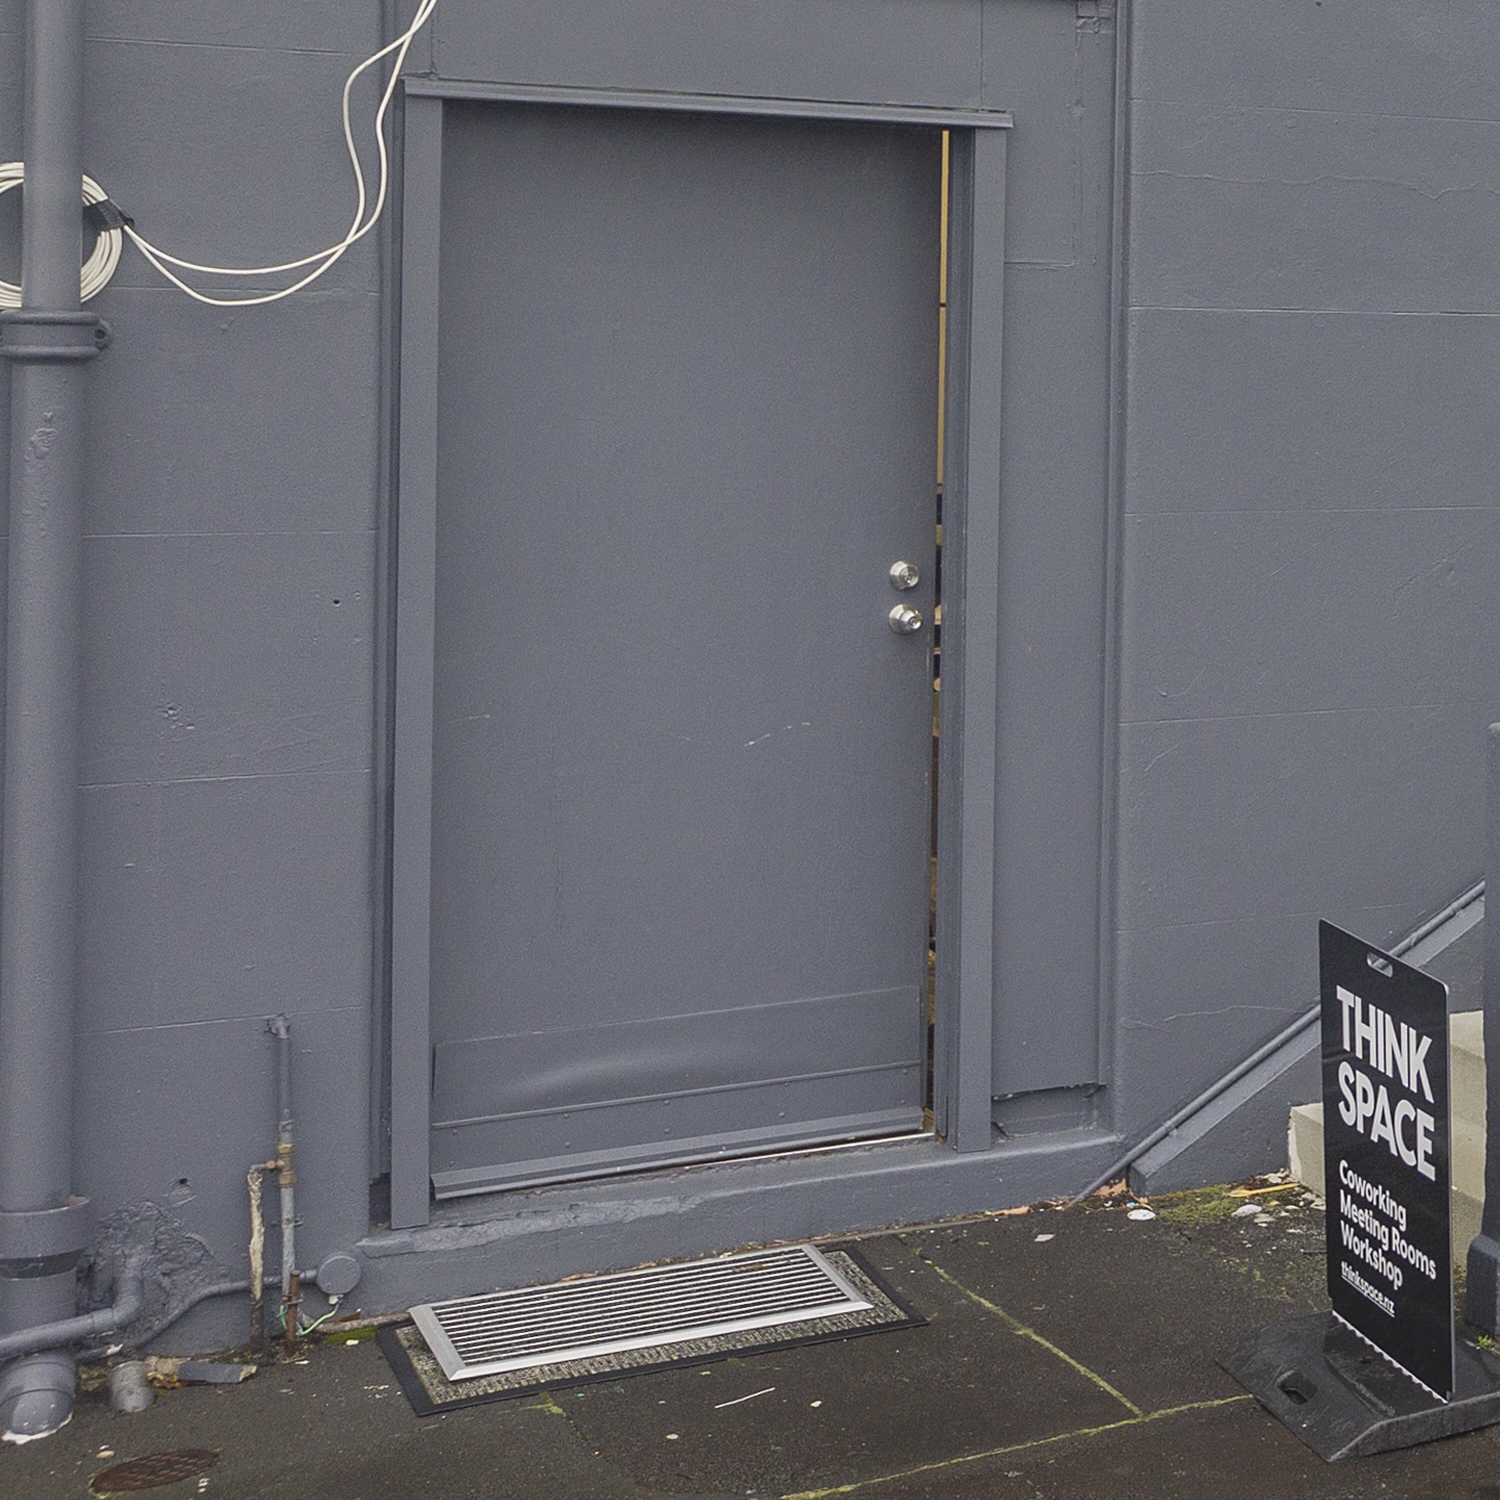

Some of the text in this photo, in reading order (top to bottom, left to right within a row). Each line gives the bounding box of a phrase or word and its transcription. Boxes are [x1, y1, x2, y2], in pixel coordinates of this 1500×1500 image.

[1336, 985, 1435, 1104] THINK
[1338, 1061, 1436, 1182] SPACE
[1339, 1159, 1407, 1232] Coworking
[1340, 1189, 1437, 1280] Meeting Rooms
[1340, 1220, 1403, 1291] Workshop
[1341, 1260, 1395, 1315] thinkspace.nz
